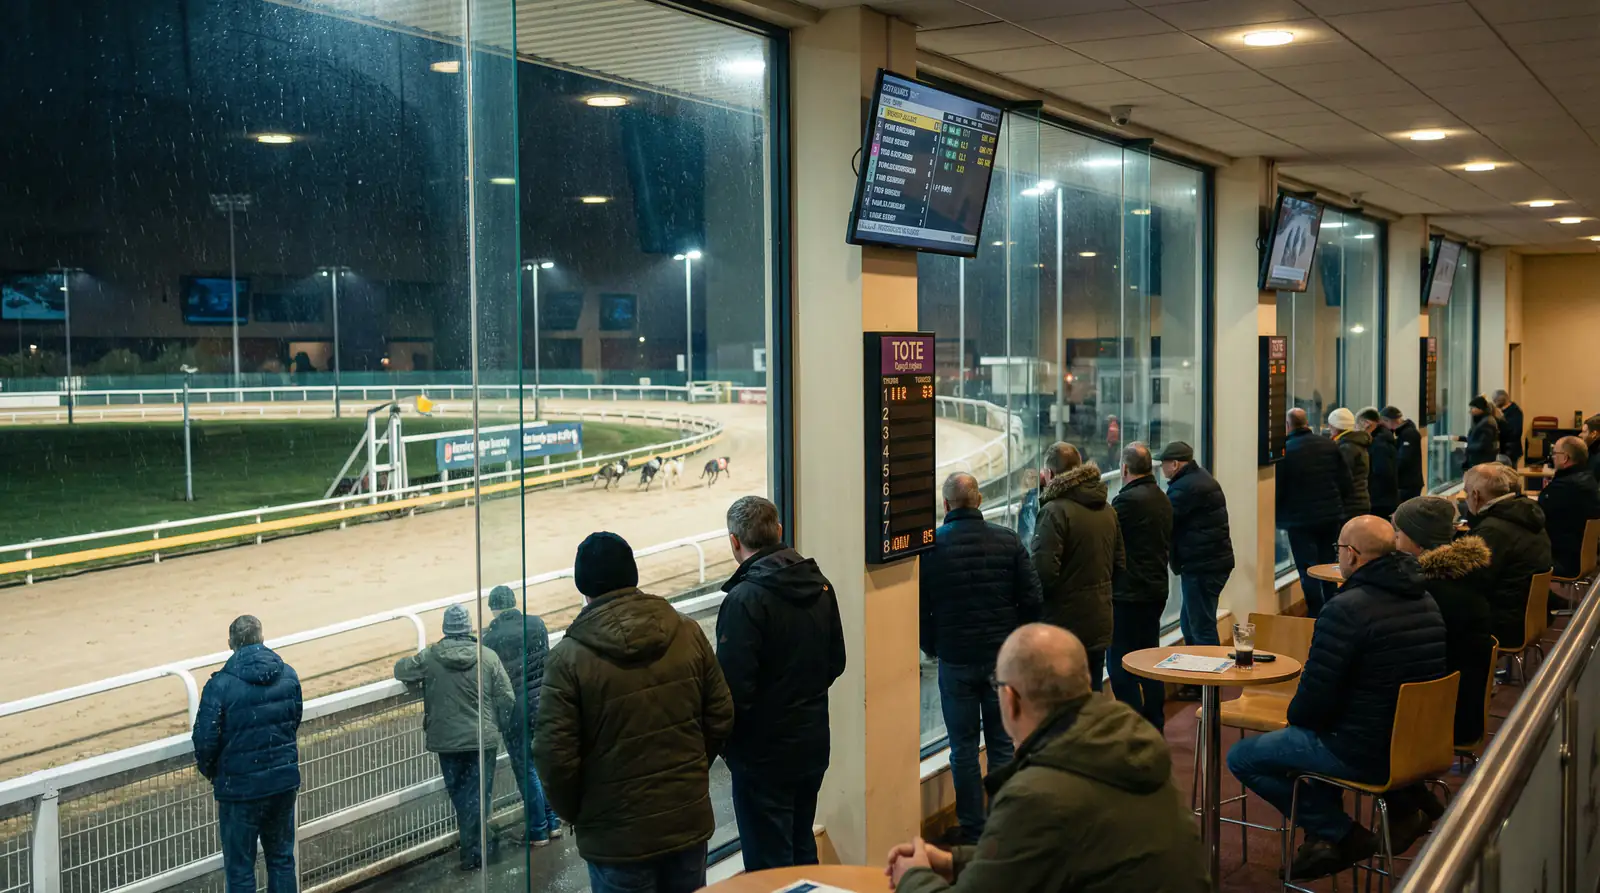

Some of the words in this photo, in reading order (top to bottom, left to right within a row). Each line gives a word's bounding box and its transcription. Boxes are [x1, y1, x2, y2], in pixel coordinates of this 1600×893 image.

[892, 341, 924, 361] TOTE
[883, 388, 888, 401] 1
[882, 407, 889, 420] 2
[882, 426, 889, 440] 3
[882, 445, 890, 458] 4
[882, 464, 890, 477] 5
[882, 483, 890, 496] 6
[883, 502, 890, 515] 7
[883, 520, 890, 534] 7
[883, 540, 890, 553] 8
